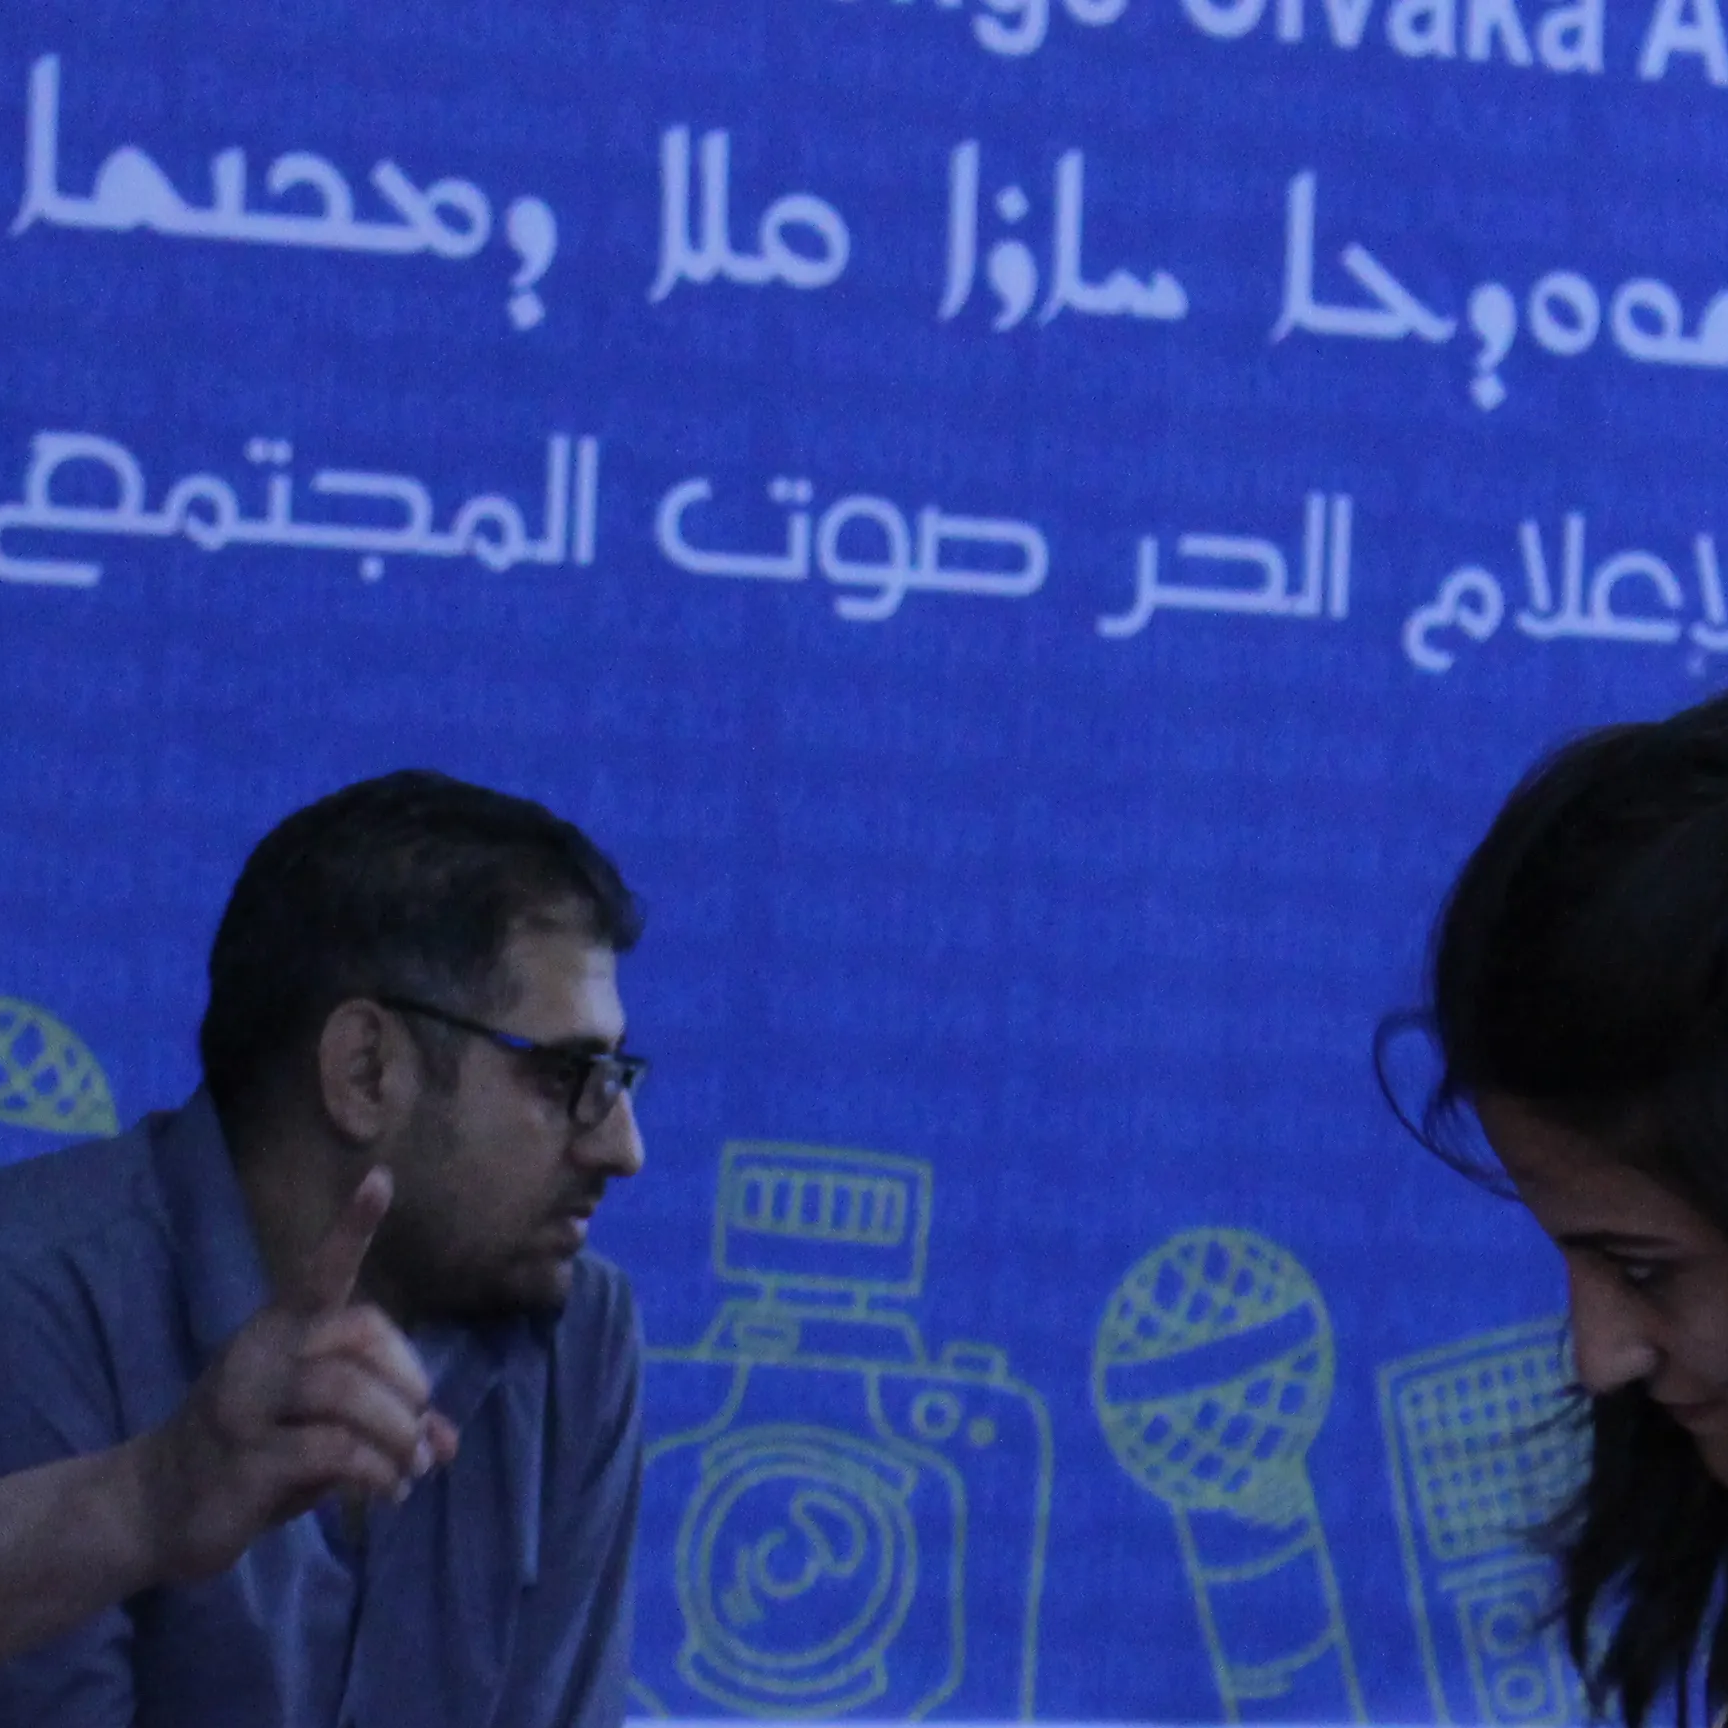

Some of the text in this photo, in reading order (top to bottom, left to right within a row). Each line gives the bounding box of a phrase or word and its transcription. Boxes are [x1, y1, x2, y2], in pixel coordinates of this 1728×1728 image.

[1182, 0, 1605, 75] vaka
[654, 476, 1051, 623] صوت
[1096, 492, 1353, 639] الحر
